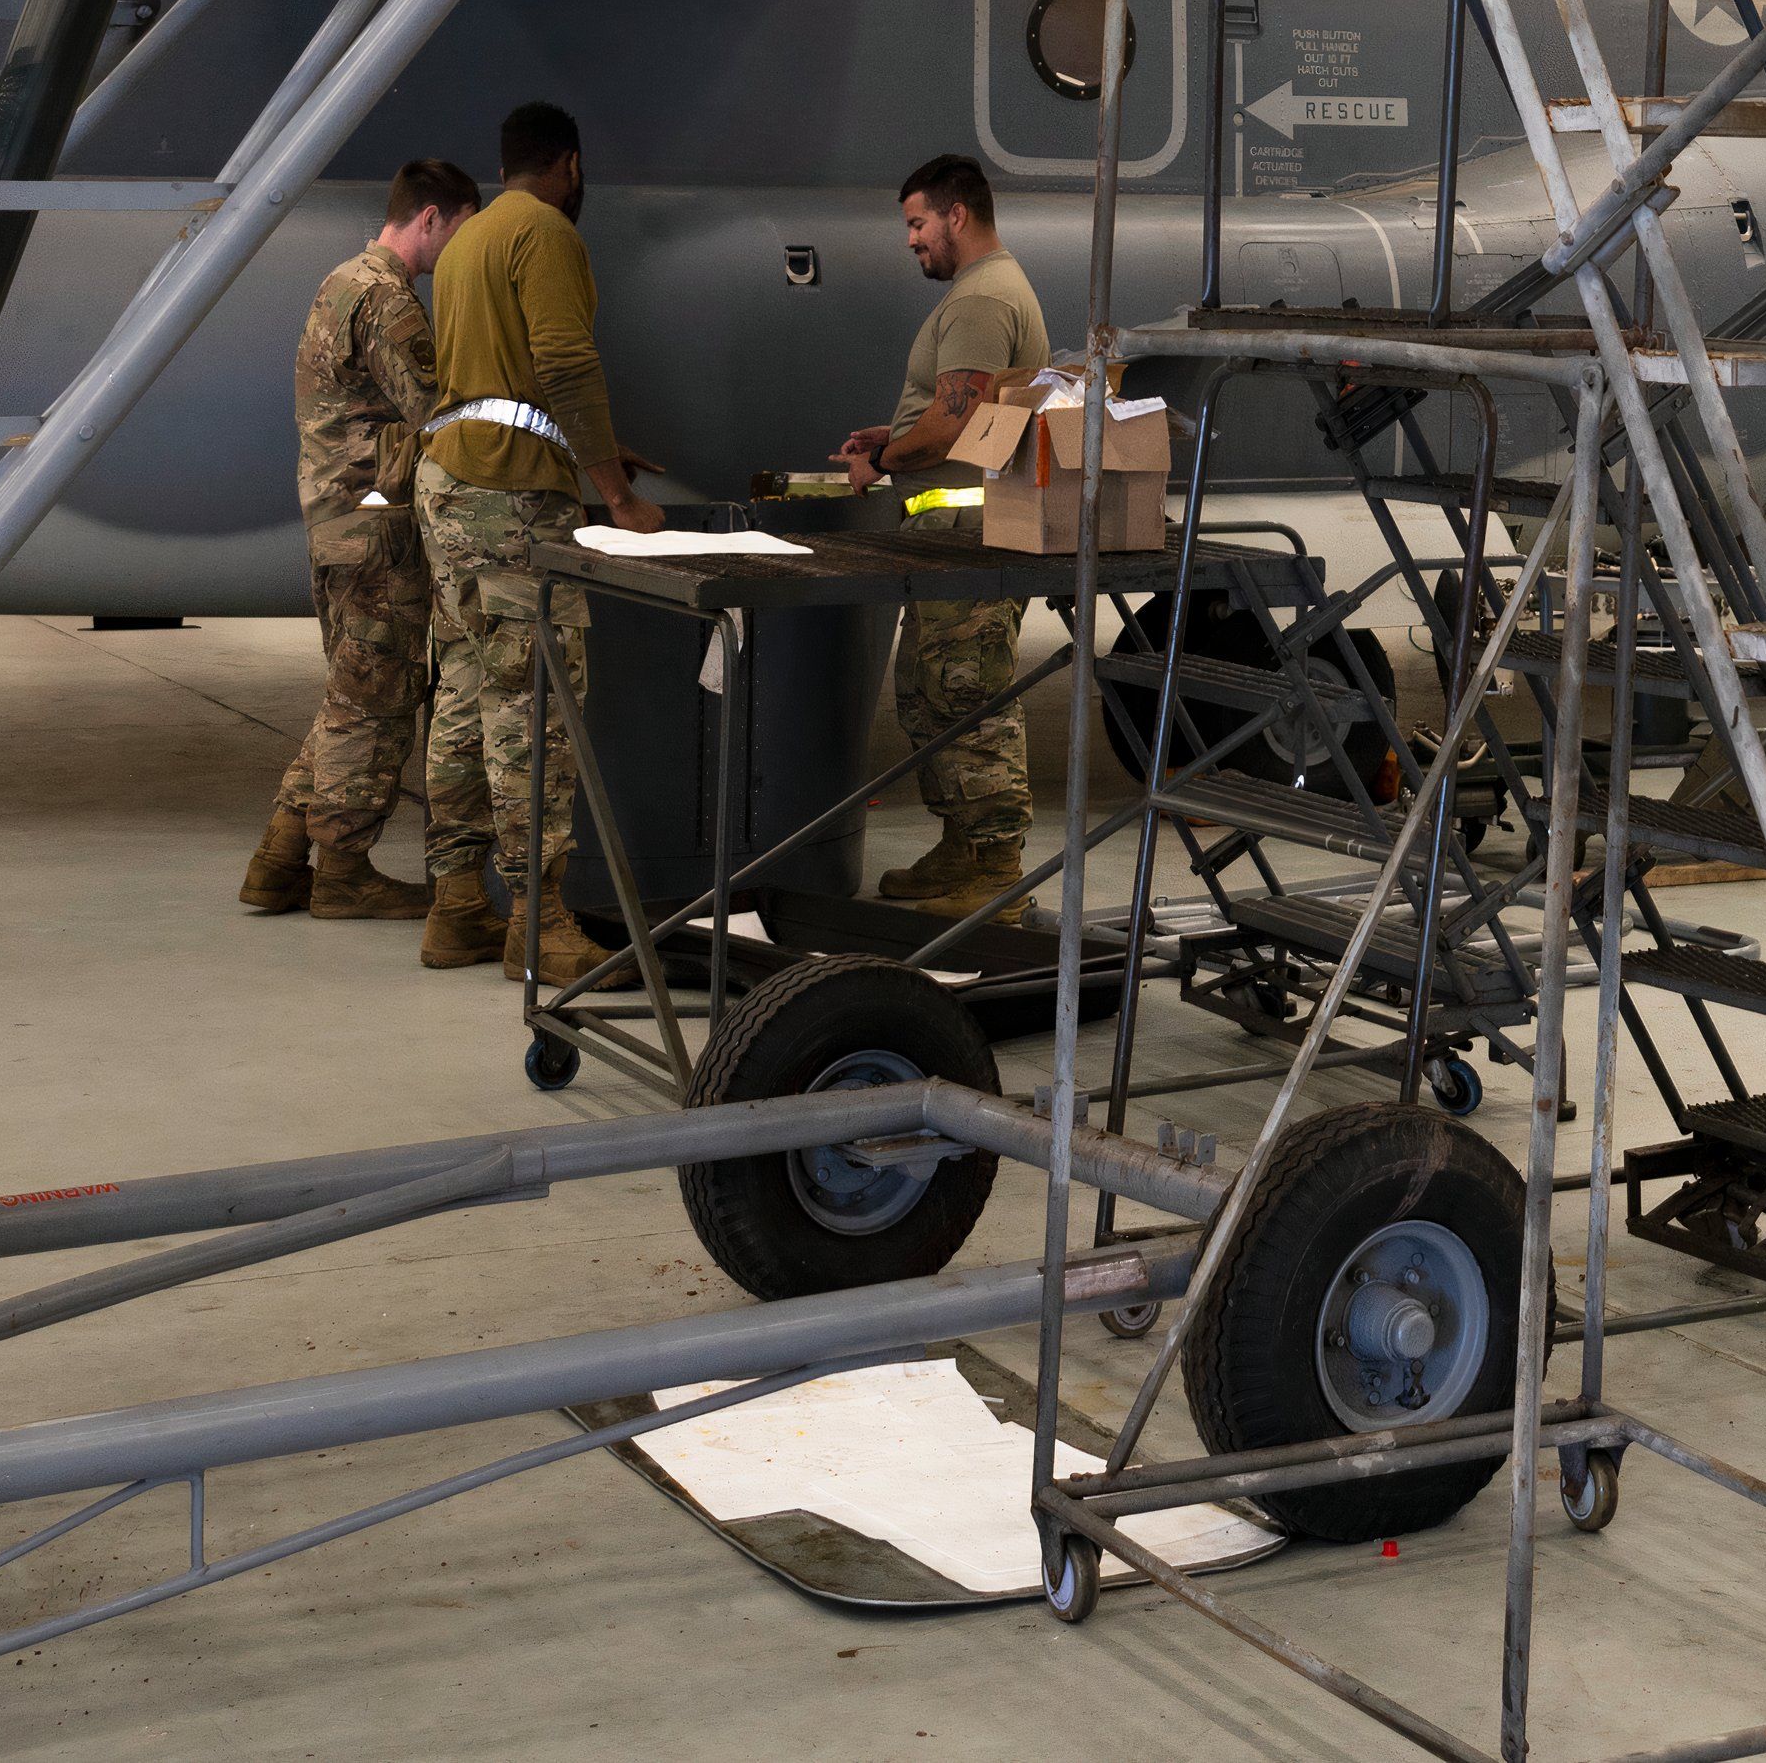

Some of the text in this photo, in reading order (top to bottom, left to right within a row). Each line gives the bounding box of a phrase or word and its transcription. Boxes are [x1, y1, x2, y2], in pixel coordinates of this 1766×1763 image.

[1292, 29, 1361, 41] PUSH BUTTON
[1295, 41, 1359, 53] PULL HANDLE
[1304, 54, 1324, 63] OUT
[1297, 65, 1329, 75] HATCH
[1318, 78, 1338, 88] OUT
[1305, 101, 1396, 121] RESCUE
[1250, 146, 1304, 159] CARTRIDGE
[1251, 162, 1303, 172] ACTUATED
